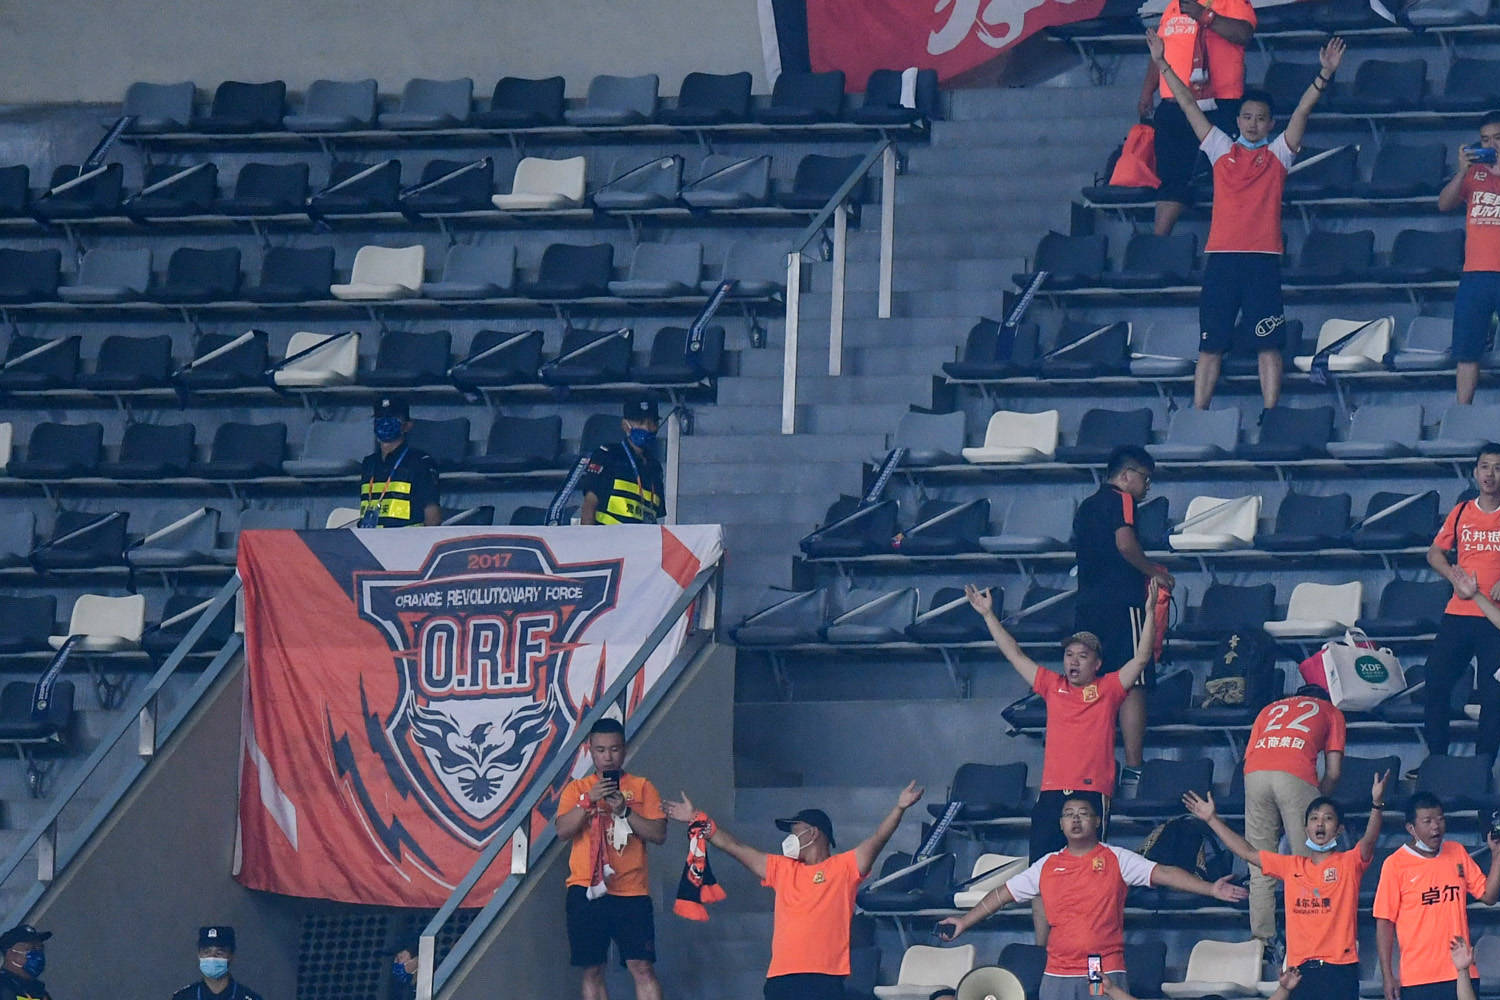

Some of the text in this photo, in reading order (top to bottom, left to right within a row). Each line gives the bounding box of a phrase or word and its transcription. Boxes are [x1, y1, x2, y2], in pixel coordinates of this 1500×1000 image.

[468, 553, 512, 568] 2017
[395, 586, 583, 608] ORANGE REVOLUTIONARY FORCE
[1360, 663, 1381, 671] XDF
[1264, 700, 1320, 733] 22
[1421, 884, 1460, 906] 卓尔
